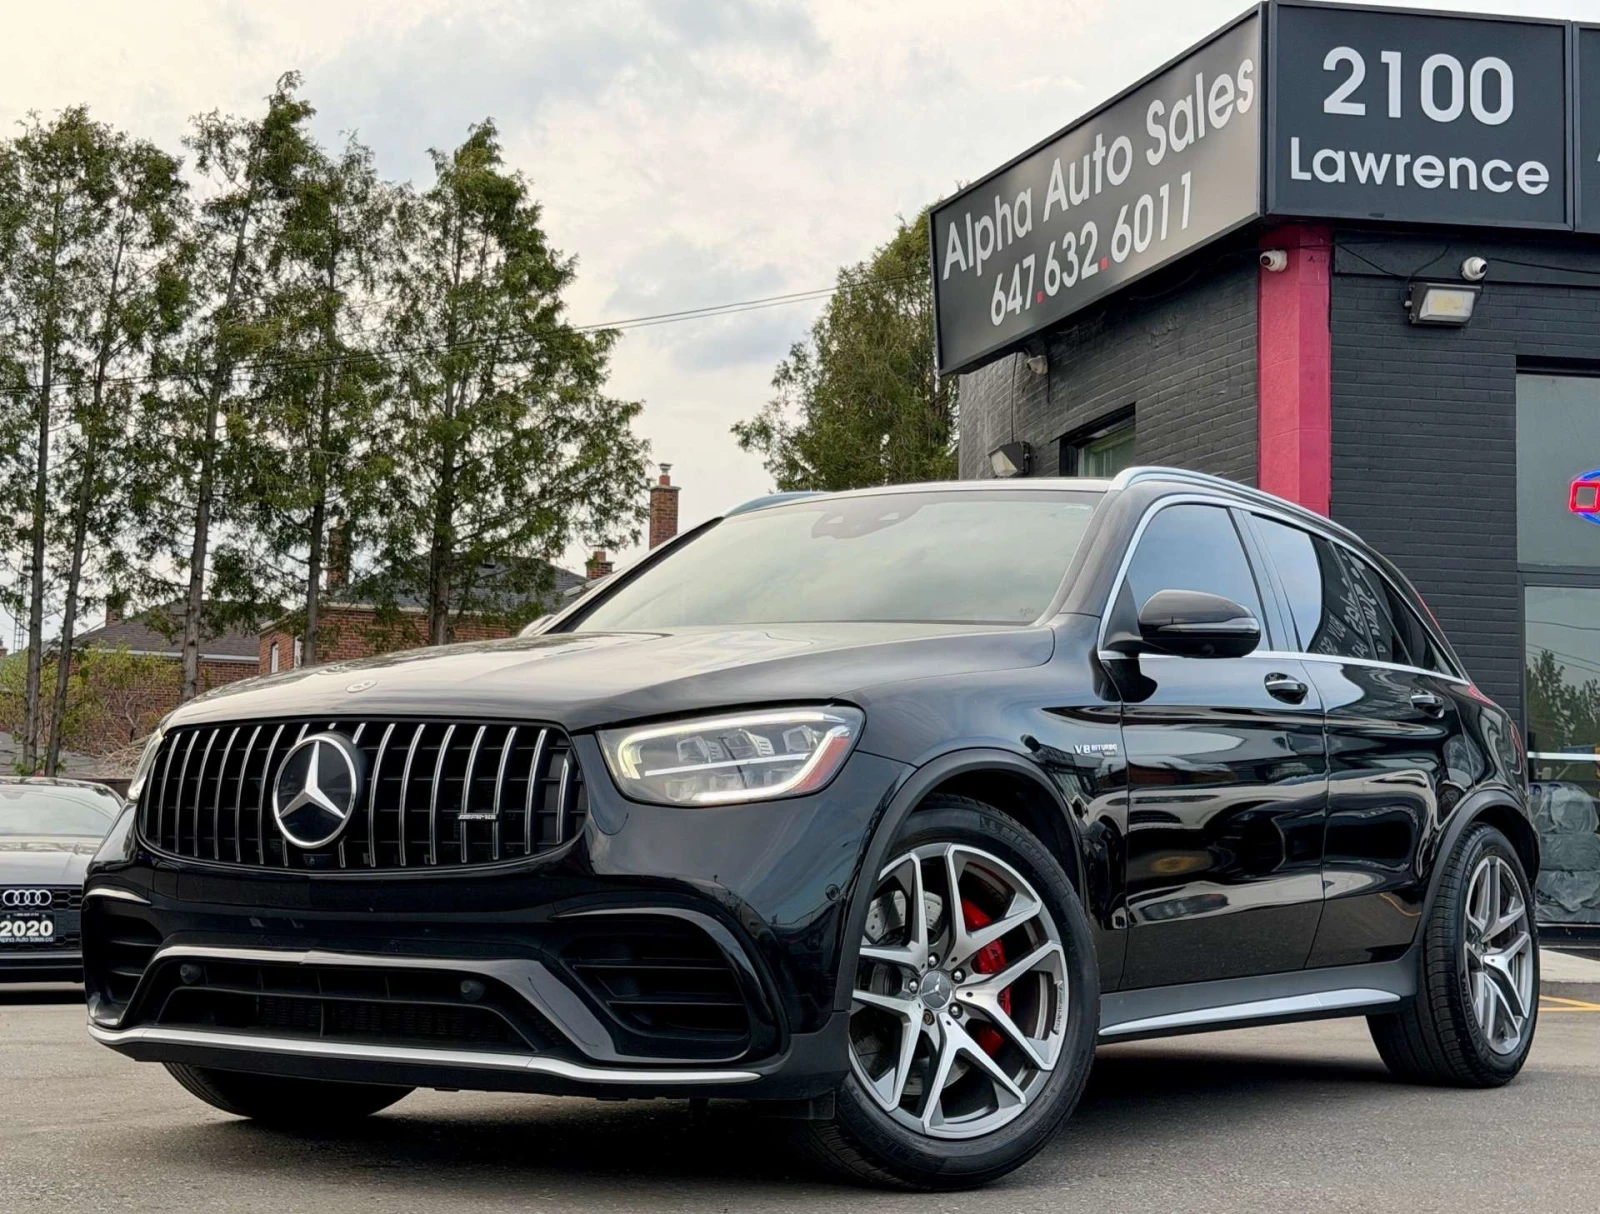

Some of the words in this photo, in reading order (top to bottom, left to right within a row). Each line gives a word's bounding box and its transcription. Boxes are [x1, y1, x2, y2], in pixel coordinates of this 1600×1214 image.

[1323, 46, 1514, 126] 2100
[942, 187, 1033, 281] Alpha
[1043, 133, 1133, 222] Auto
[1146, 58, 1254, 166] Sales
[1290, 136, 1550, 195] Lawrence
[990, 170, 1192, 326] 647.632.6011
[1074, 744, 1091, 754] V8
[0, 920, 54, 937] 2020
